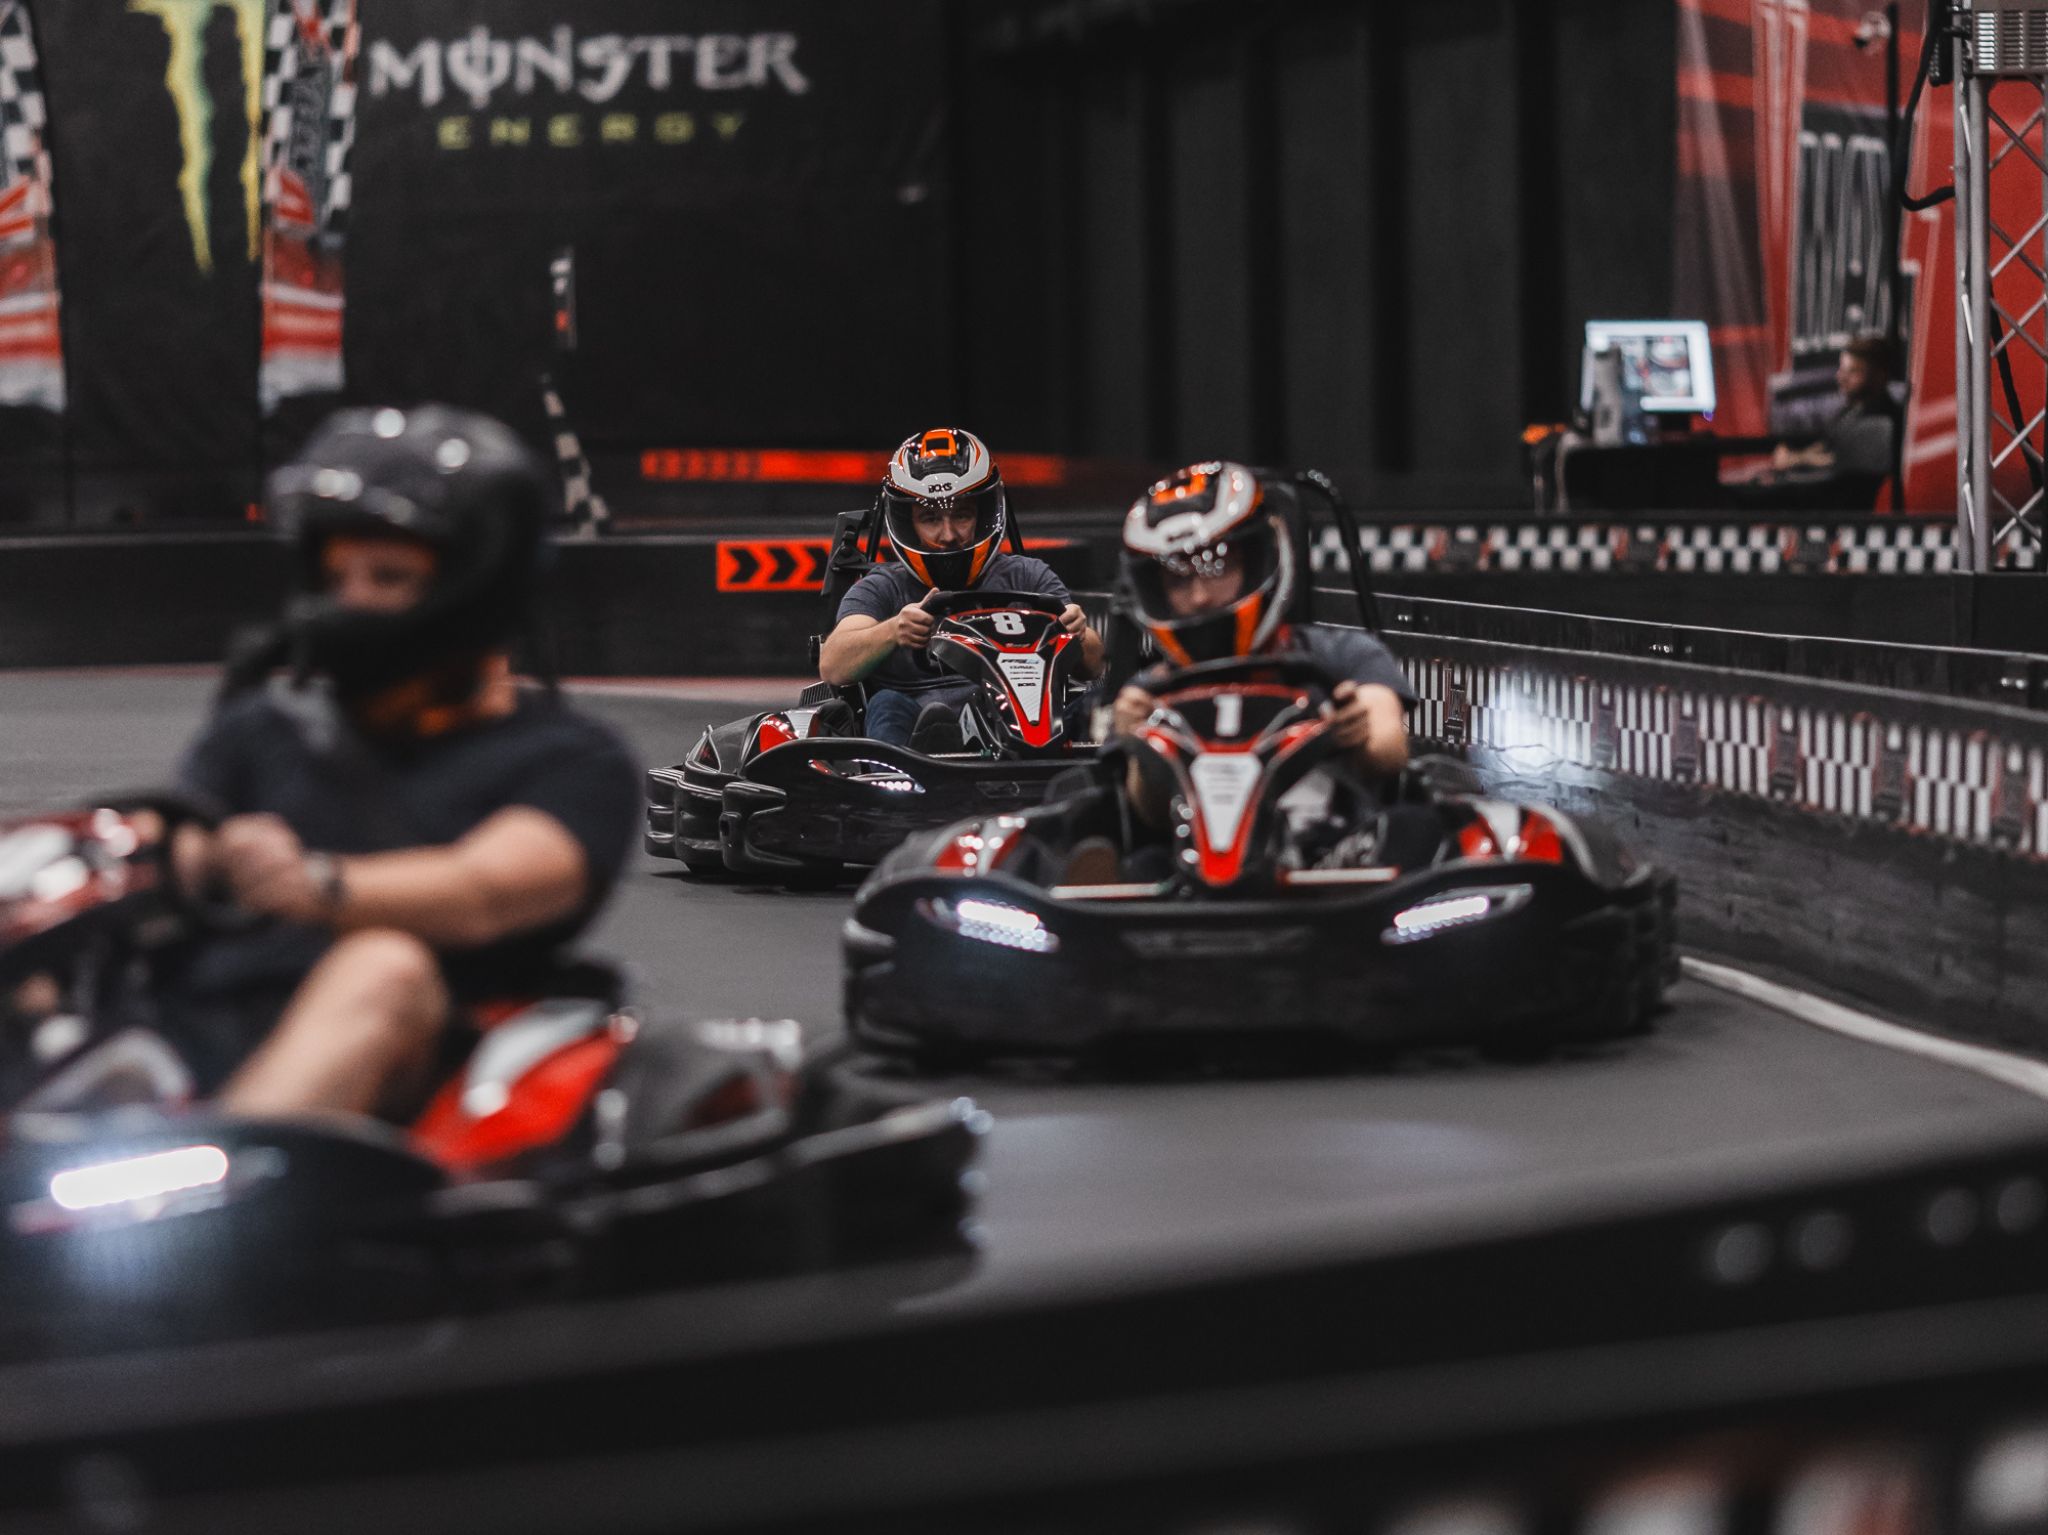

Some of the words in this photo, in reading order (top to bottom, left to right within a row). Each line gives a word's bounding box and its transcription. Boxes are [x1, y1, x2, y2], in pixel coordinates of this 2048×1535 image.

[369, 25, 809, 107] MONSTER
[437, 113, 743, 149] ENERGY
[991, 612, 1025, 635] 8
[1213, 694, 1242, 737] 1
